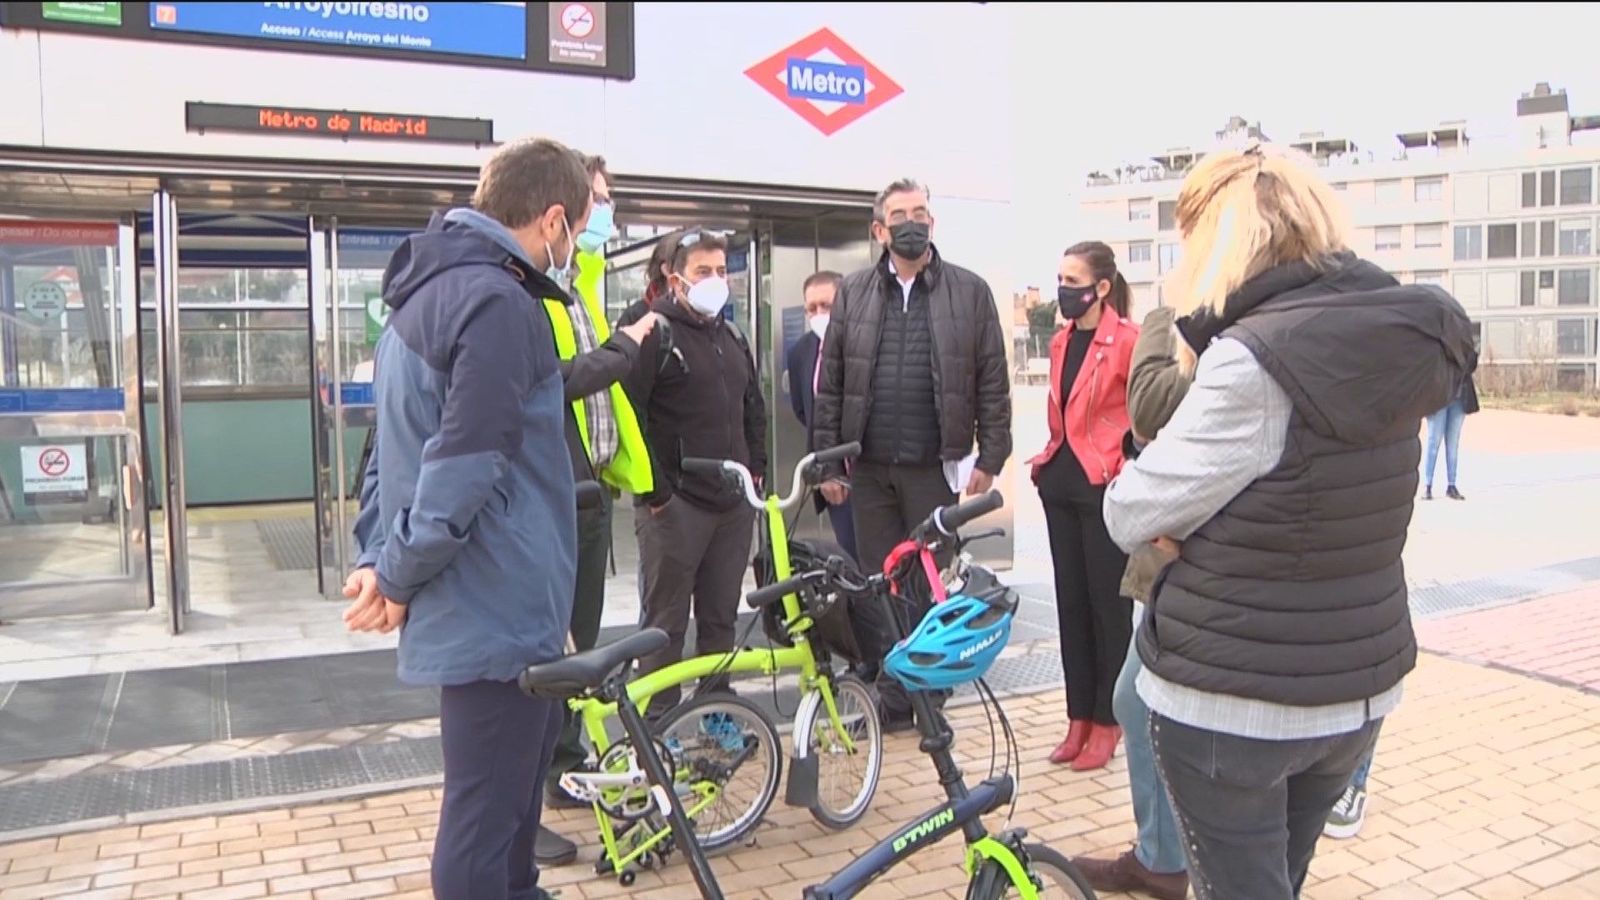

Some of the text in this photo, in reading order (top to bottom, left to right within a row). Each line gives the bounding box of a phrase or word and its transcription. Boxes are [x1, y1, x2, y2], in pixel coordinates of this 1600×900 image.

[264, 2, 429, 22] oyofresno
[261, 22, 301, 36] Acceso
[308, 27, 344, 40] Access
[345, 29, 380, 44] Arroyo
[383, 33, 398, 44] del
[400, 36, 431, 47] Monte
[791, 66, 861, 97] Metro
[259, 109, 426, 135] Metro de Madrid
